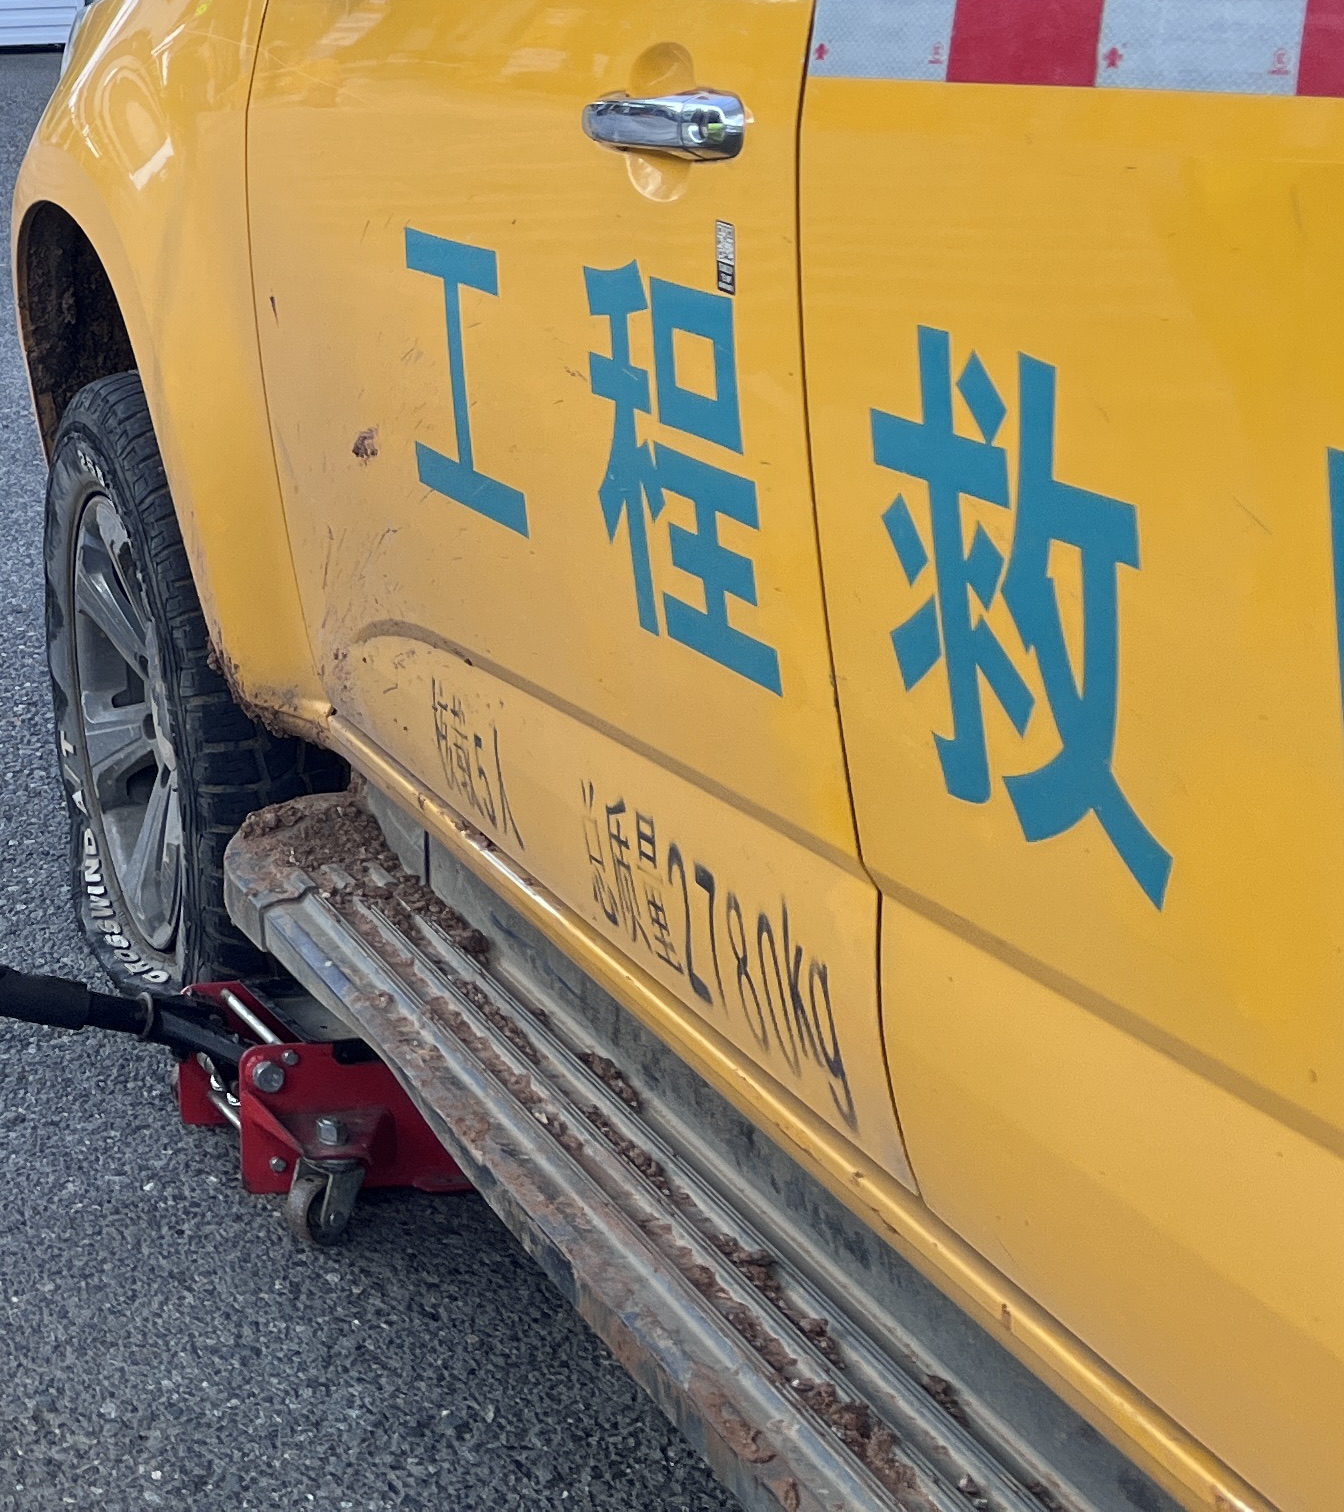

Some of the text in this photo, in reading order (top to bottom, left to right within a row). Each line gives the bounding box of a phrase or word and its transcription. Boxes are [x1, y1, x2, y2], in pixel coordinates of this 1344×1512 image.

[405, 226, 1344, 911] 工程救
[580, 778, 861, 1136] 总质量2780kg
